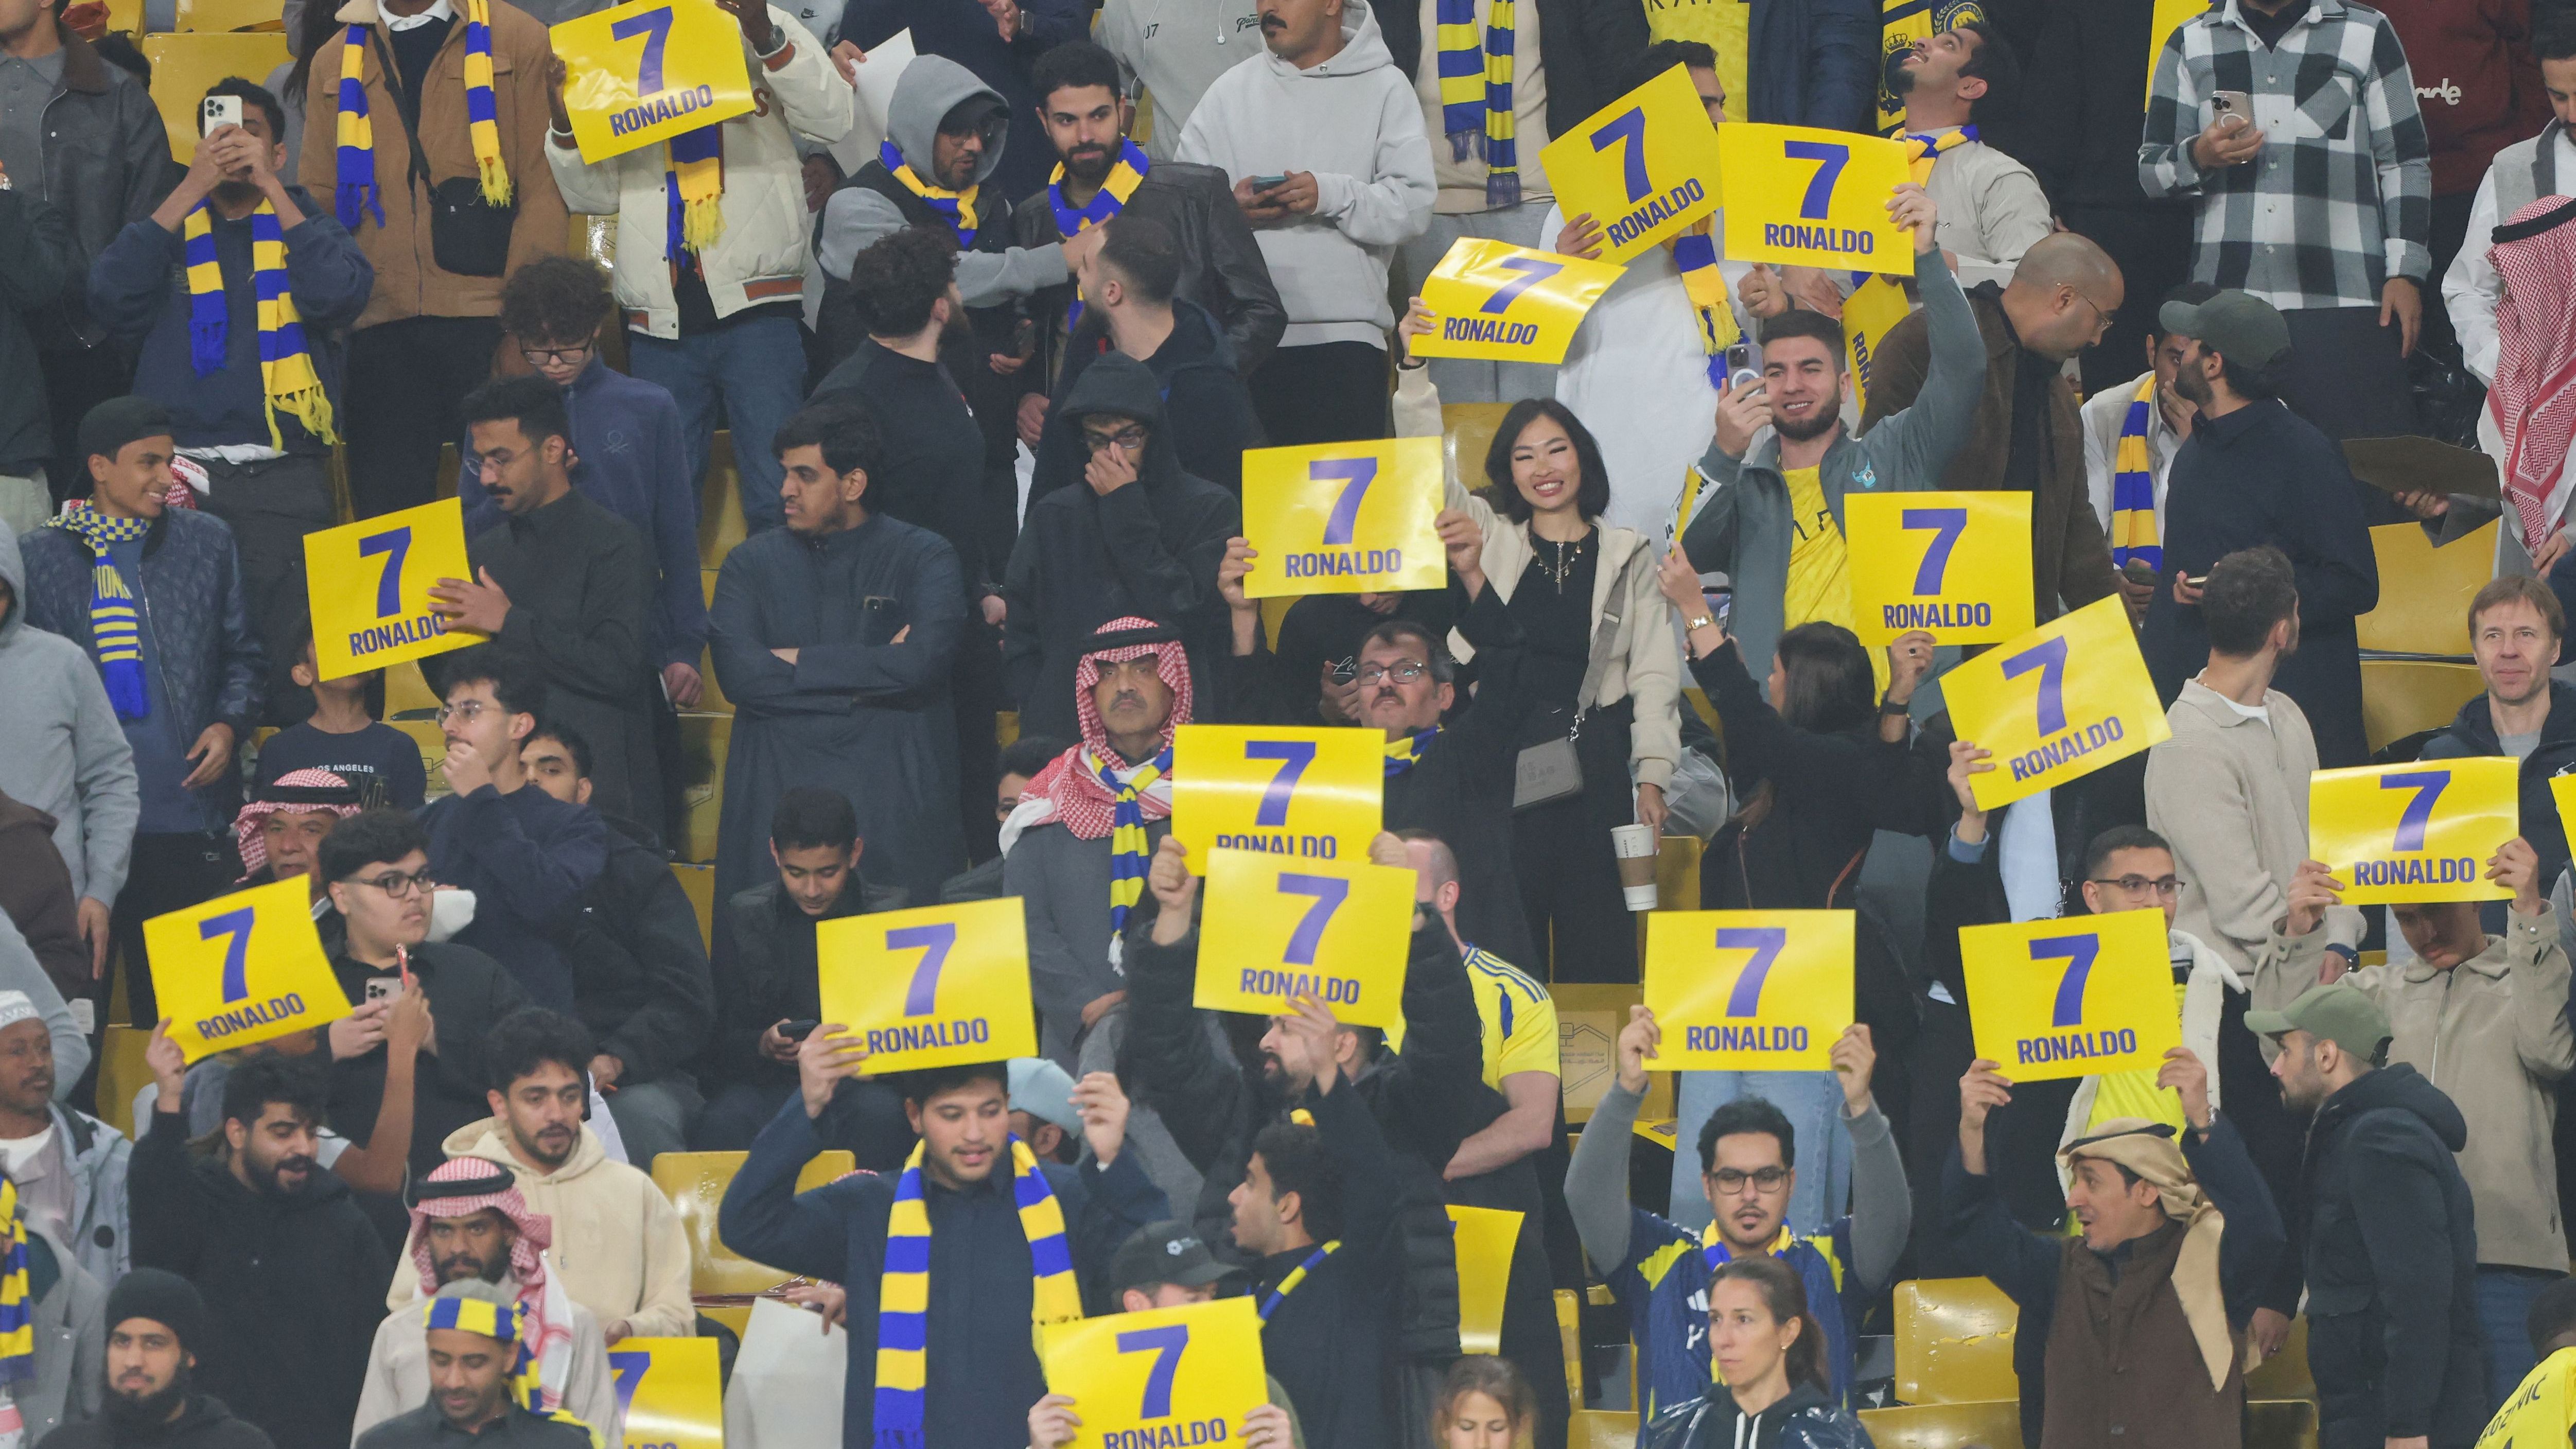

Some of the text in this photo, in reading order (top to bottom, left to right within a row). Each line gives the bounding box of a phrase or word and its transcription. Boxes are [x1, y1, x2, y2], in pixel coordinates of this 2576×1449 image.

[611, 6, 673, 96] 7
[609, 84, 712, 136] RONALDO
[1588, 107, 1652, 203] 7
[1784, 141, 1849, 220] 7
[1606, 178, 1705, 247] RONALDO
[1765, 223, 1873, 254] RONALDO
[1481, 257, 1564, 313] 7
[1444, 317, 1538, 345] RONALDO
[1310, 457, 1378, 545] 7
[360, 527, 411, 618] 7
[1286, 549, 1401, 577] RONALDO
[1902, 508, 1967, 596] 7
[350, 613, 445, 655] RONALDO
[1884, 603, 1991, 627] RONALDO
[2001, 636, 2068, 737] 7
[332, 764, 374, 773] ANGELES
[2010, 717, 2124, 781] RONALDO
[1246, 741, 1316, 826] 7
[2380, 771, 2451, 851] 7
[2355, 858, 2475, 885] RONALDO
[1278, 872, 1349, 965] 7
[200, 907, 254, 1003] 7
[886, 923, 956, 1017] 7
[1241, 969, 1360, 1004] RONALDO
[1716, 928, 1786, 1017] 7
[2029, 933, 2099, 1027] 7
[197, 993, 305, 1040] RONALDO
[867, 1019, 989, 1053] RONALDO
[1687, 1026, 1808, 1051] RONALDO
[2018, 1028, 2136, 1063] RONALDO
[1117, 1324, 1189, 1419] 7
[1103, 1418, 1226, 1449] RONALDO
